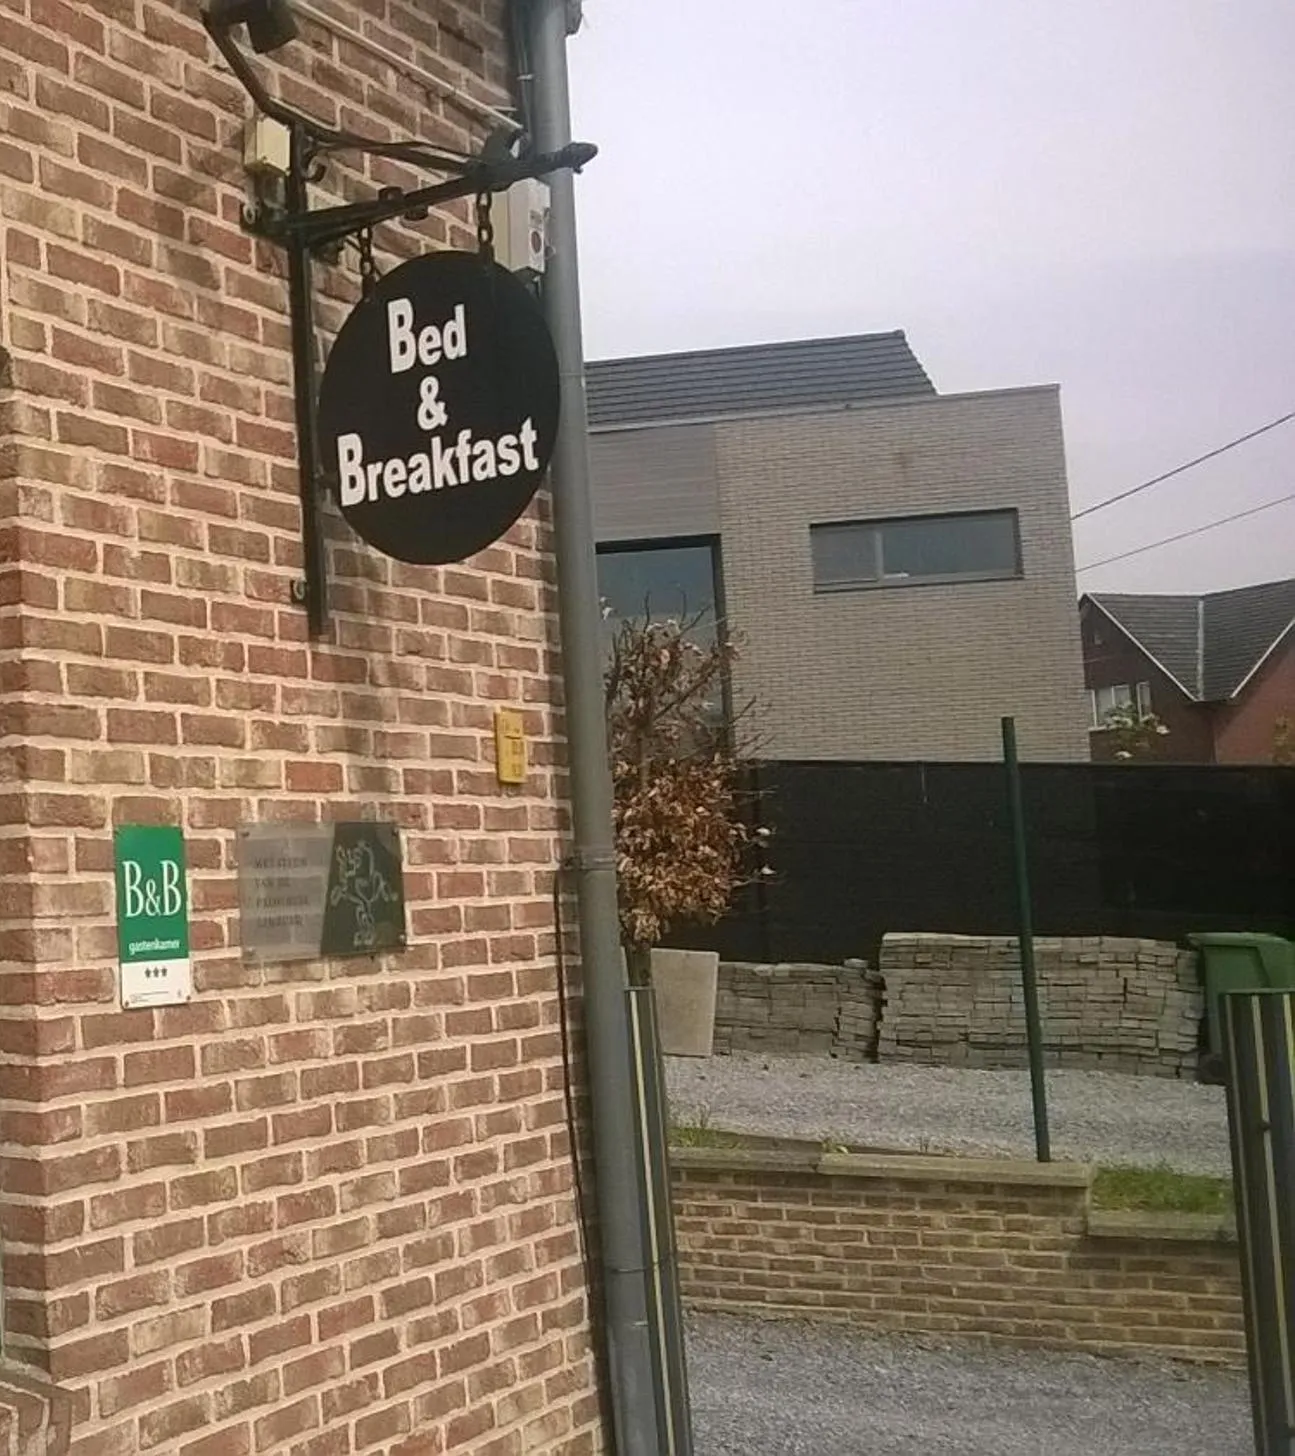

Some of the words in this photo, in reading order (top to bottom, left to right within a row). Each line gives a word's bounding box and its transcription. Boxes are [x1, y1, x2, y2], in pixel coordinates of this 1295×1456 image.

[387, 298, 467, 373] Bed
[417, 376, 448, 431] &
[337, 417, 539, 507] Breakfast
[122, 860, 182, 917] B&B
